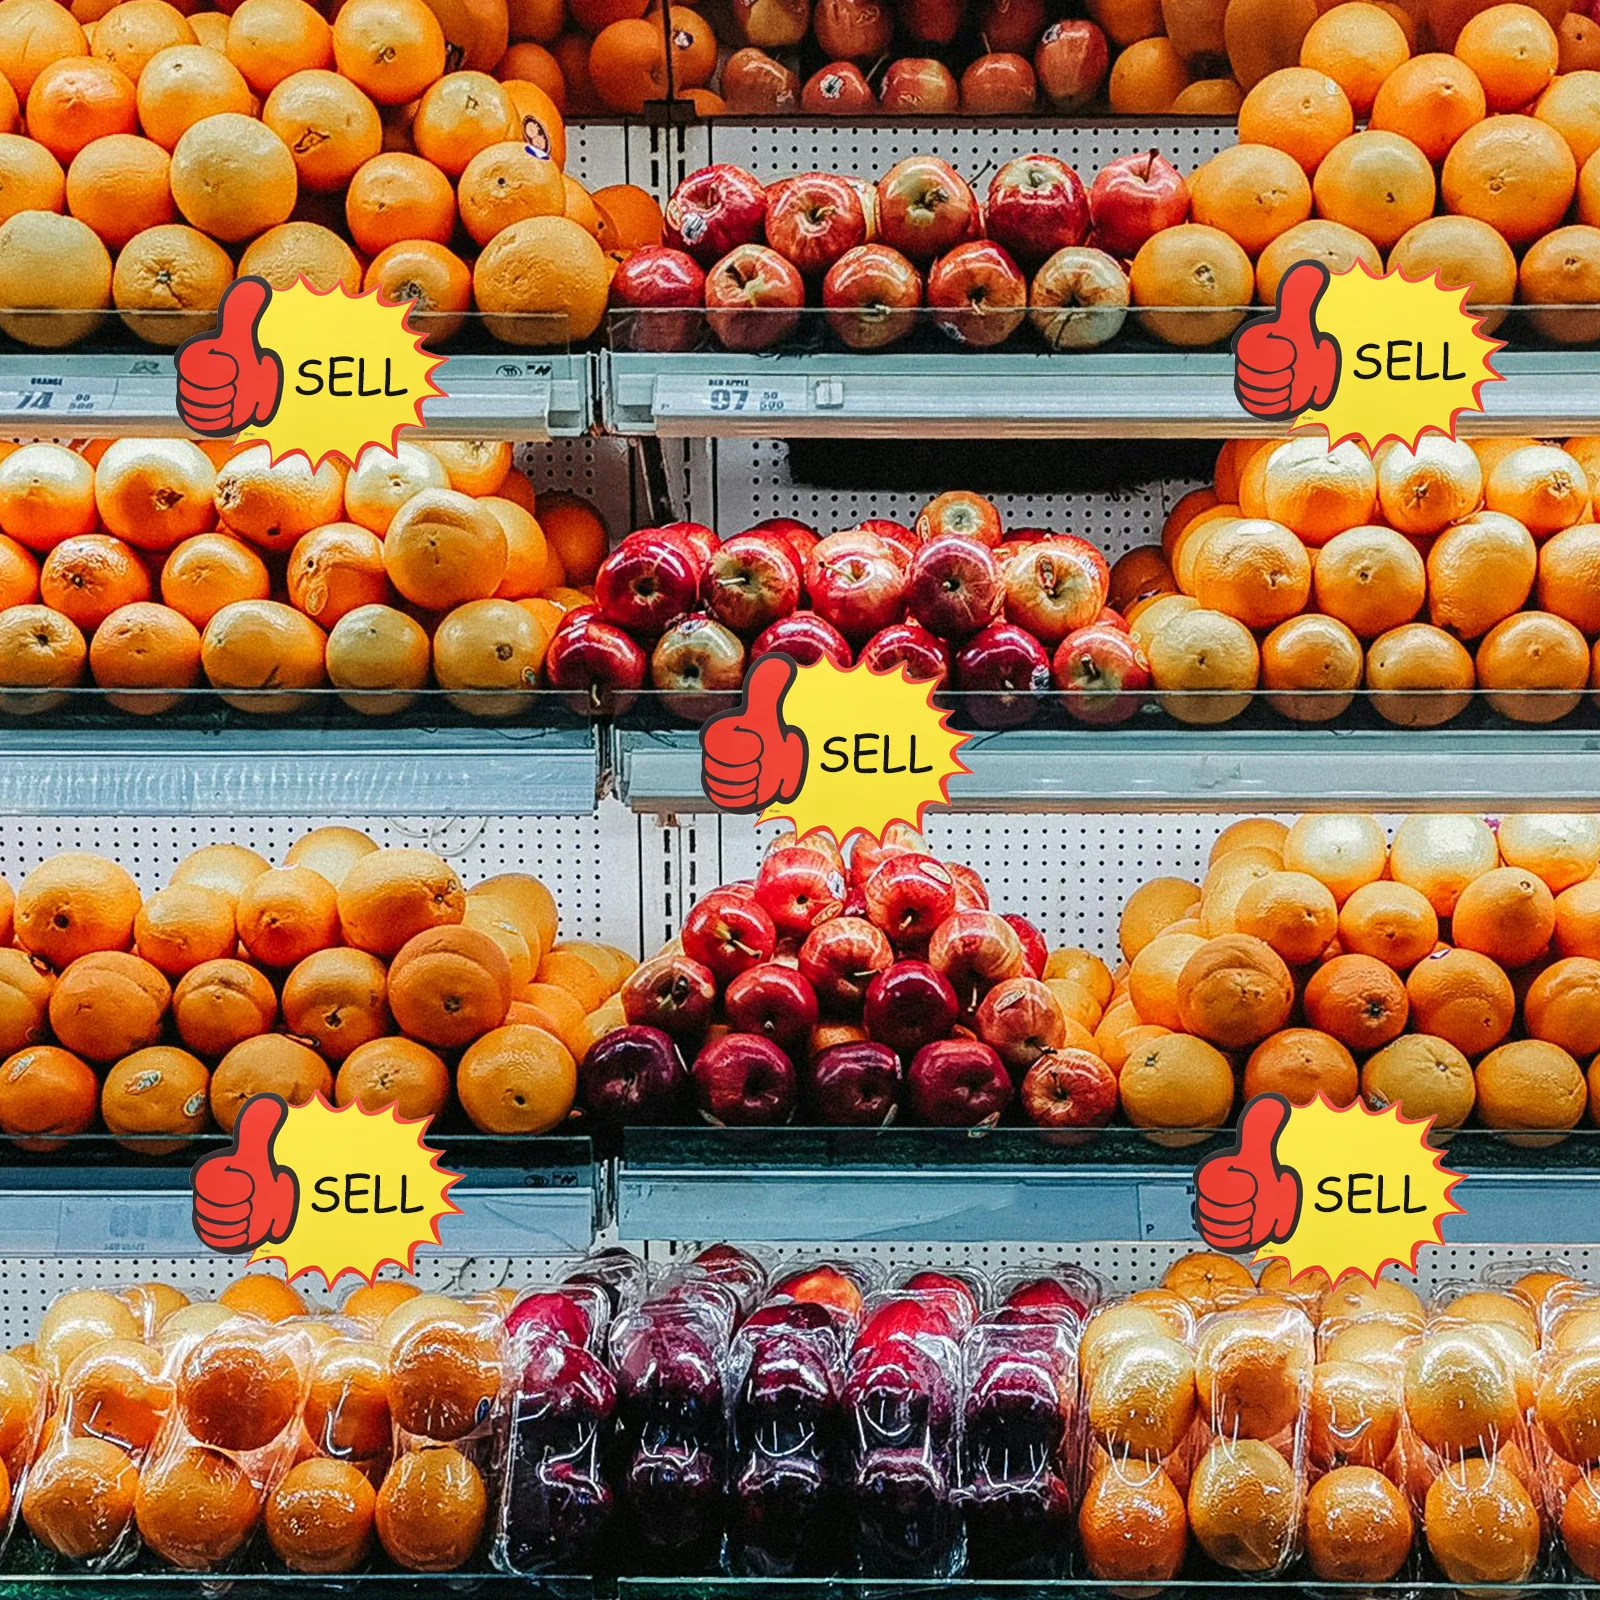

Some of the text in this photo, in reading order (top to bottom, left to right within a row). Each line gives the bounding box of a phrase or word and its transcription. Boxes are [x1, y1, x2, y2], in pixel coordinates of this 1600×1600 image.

[710, 389, 749, 411] 97
[763, 391, 778, 399] 50
[1146, 1223, 1155, 1234] P
